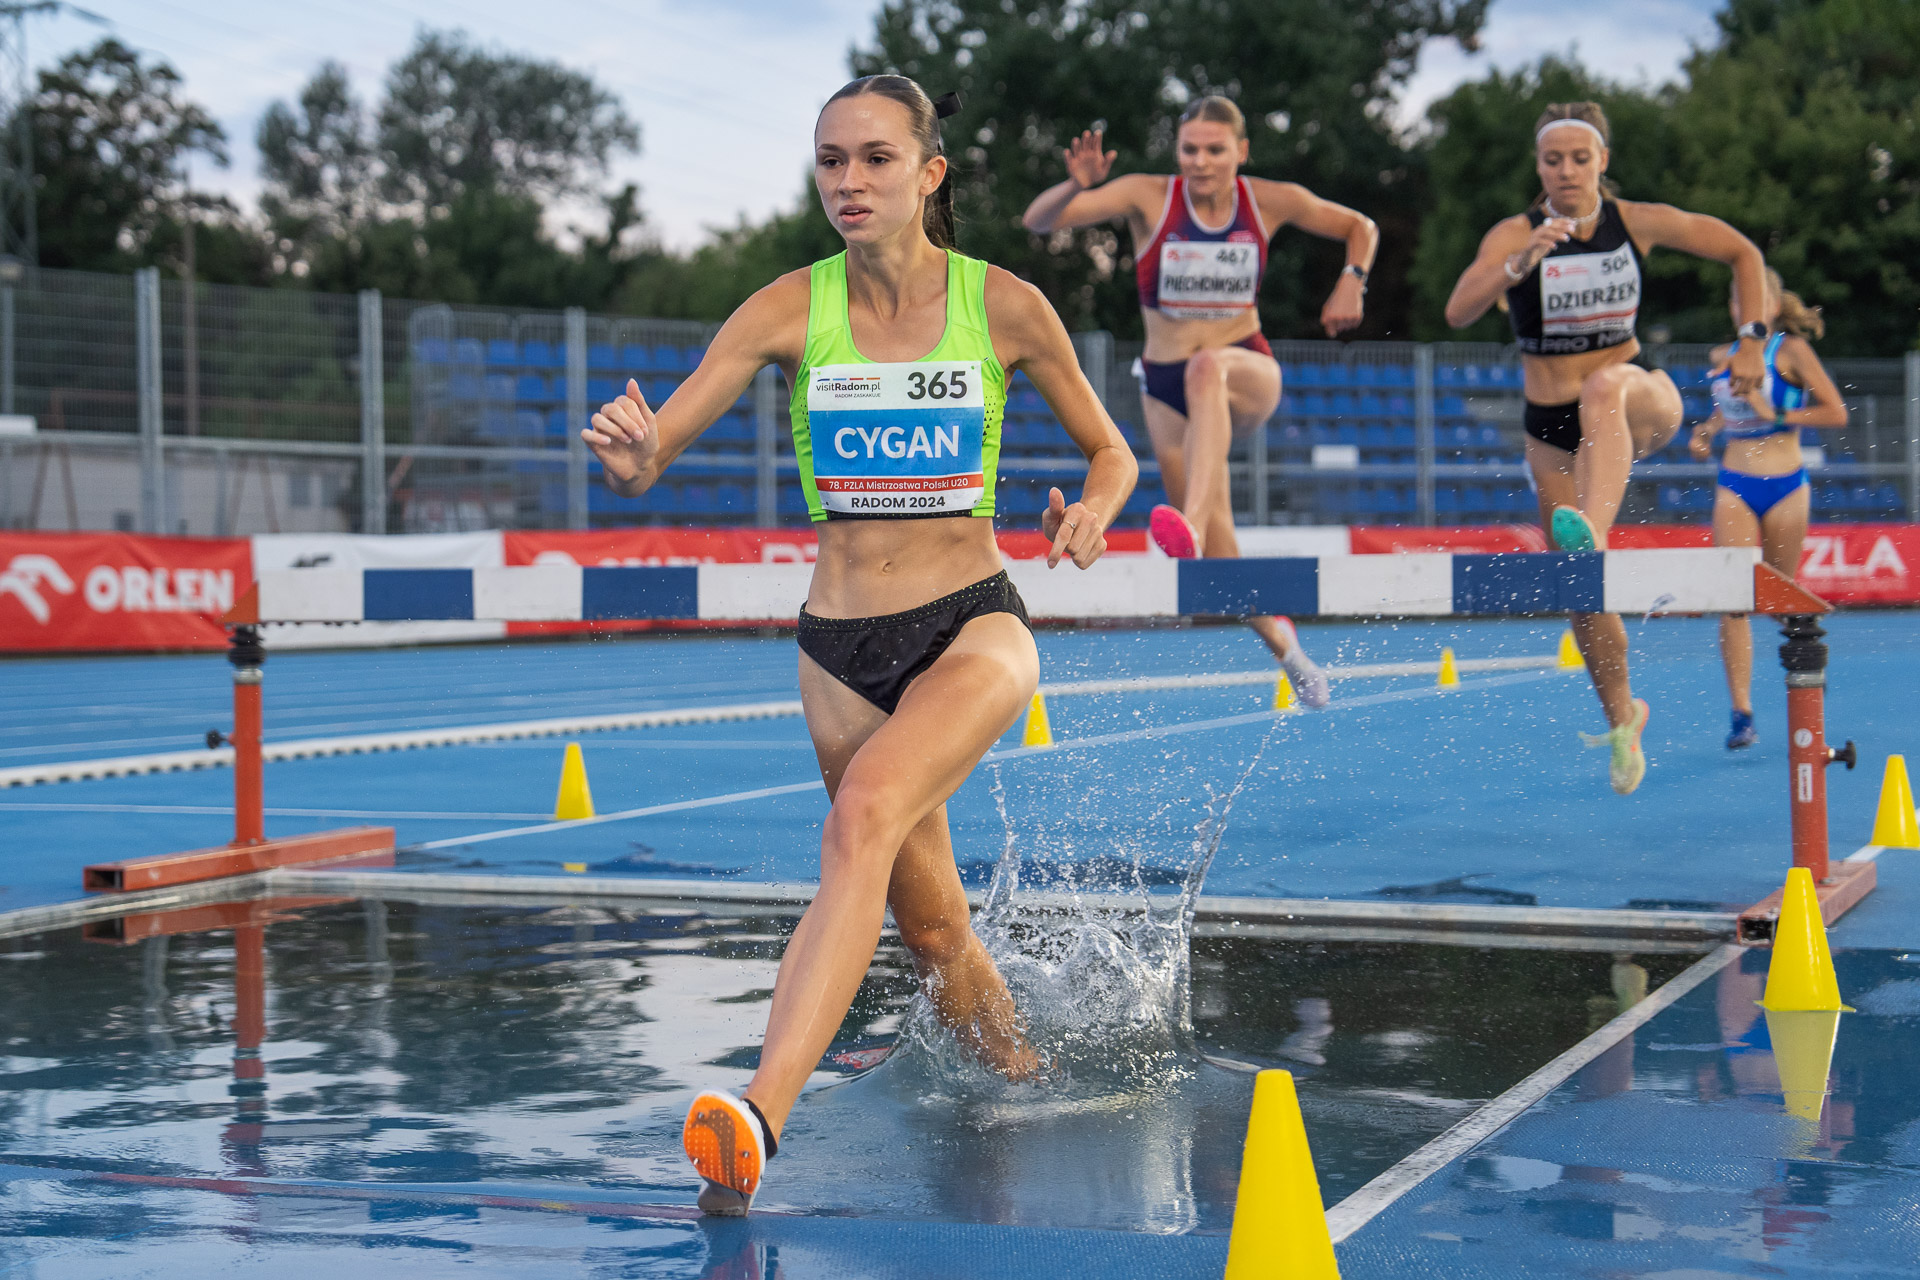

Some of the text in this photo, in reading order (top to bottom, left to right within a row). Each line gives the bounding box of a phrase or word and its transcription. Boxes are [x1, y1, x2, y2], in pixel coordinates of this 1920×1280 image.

[1548, 278, 1637, 310] DZIERŻEK
[816, 381, 881, 392] visitRadom.pl
[907, 370, 968, 400] 365
[834, 425, 960, 459] CYGAN
[828, 478, 969, 490] 78. PZLA Mistrzostwa Polski U20
[851, 496, 946, 508] RADOM 2024
[1802, 535, 1907, 578] ZLA
[85, 565, 234, 613] ORLEN
